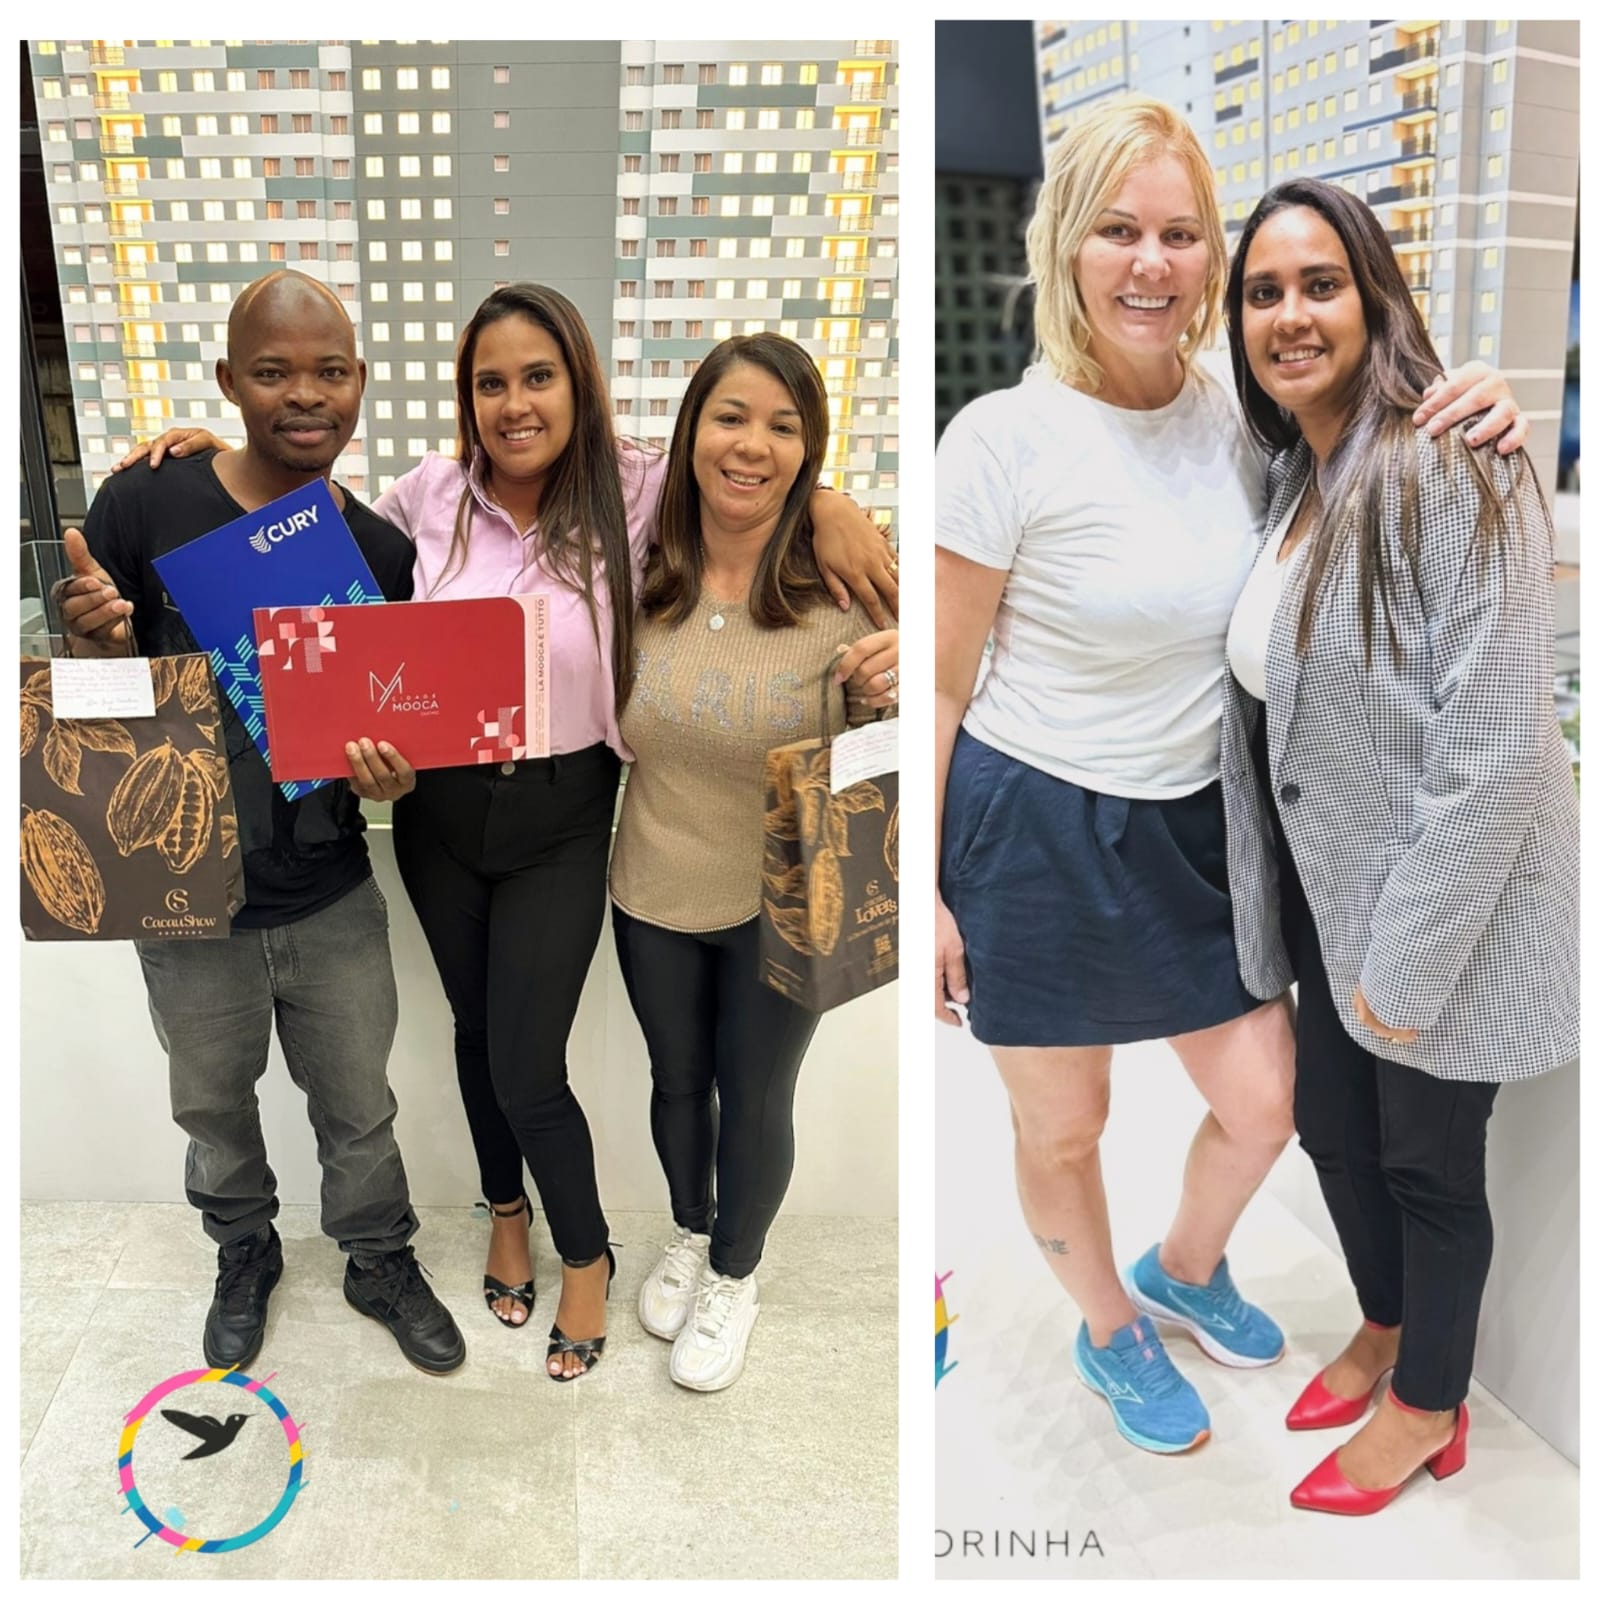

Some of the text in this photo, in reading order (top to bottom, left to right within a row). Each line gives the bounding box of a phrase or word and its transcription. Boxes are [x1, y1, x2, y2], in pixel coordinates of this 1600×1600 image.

[267, 504, 319, 543] CURY
[392, 699, 440, 713] MOOCA
[141, 914, 217, 930] CacauShow
